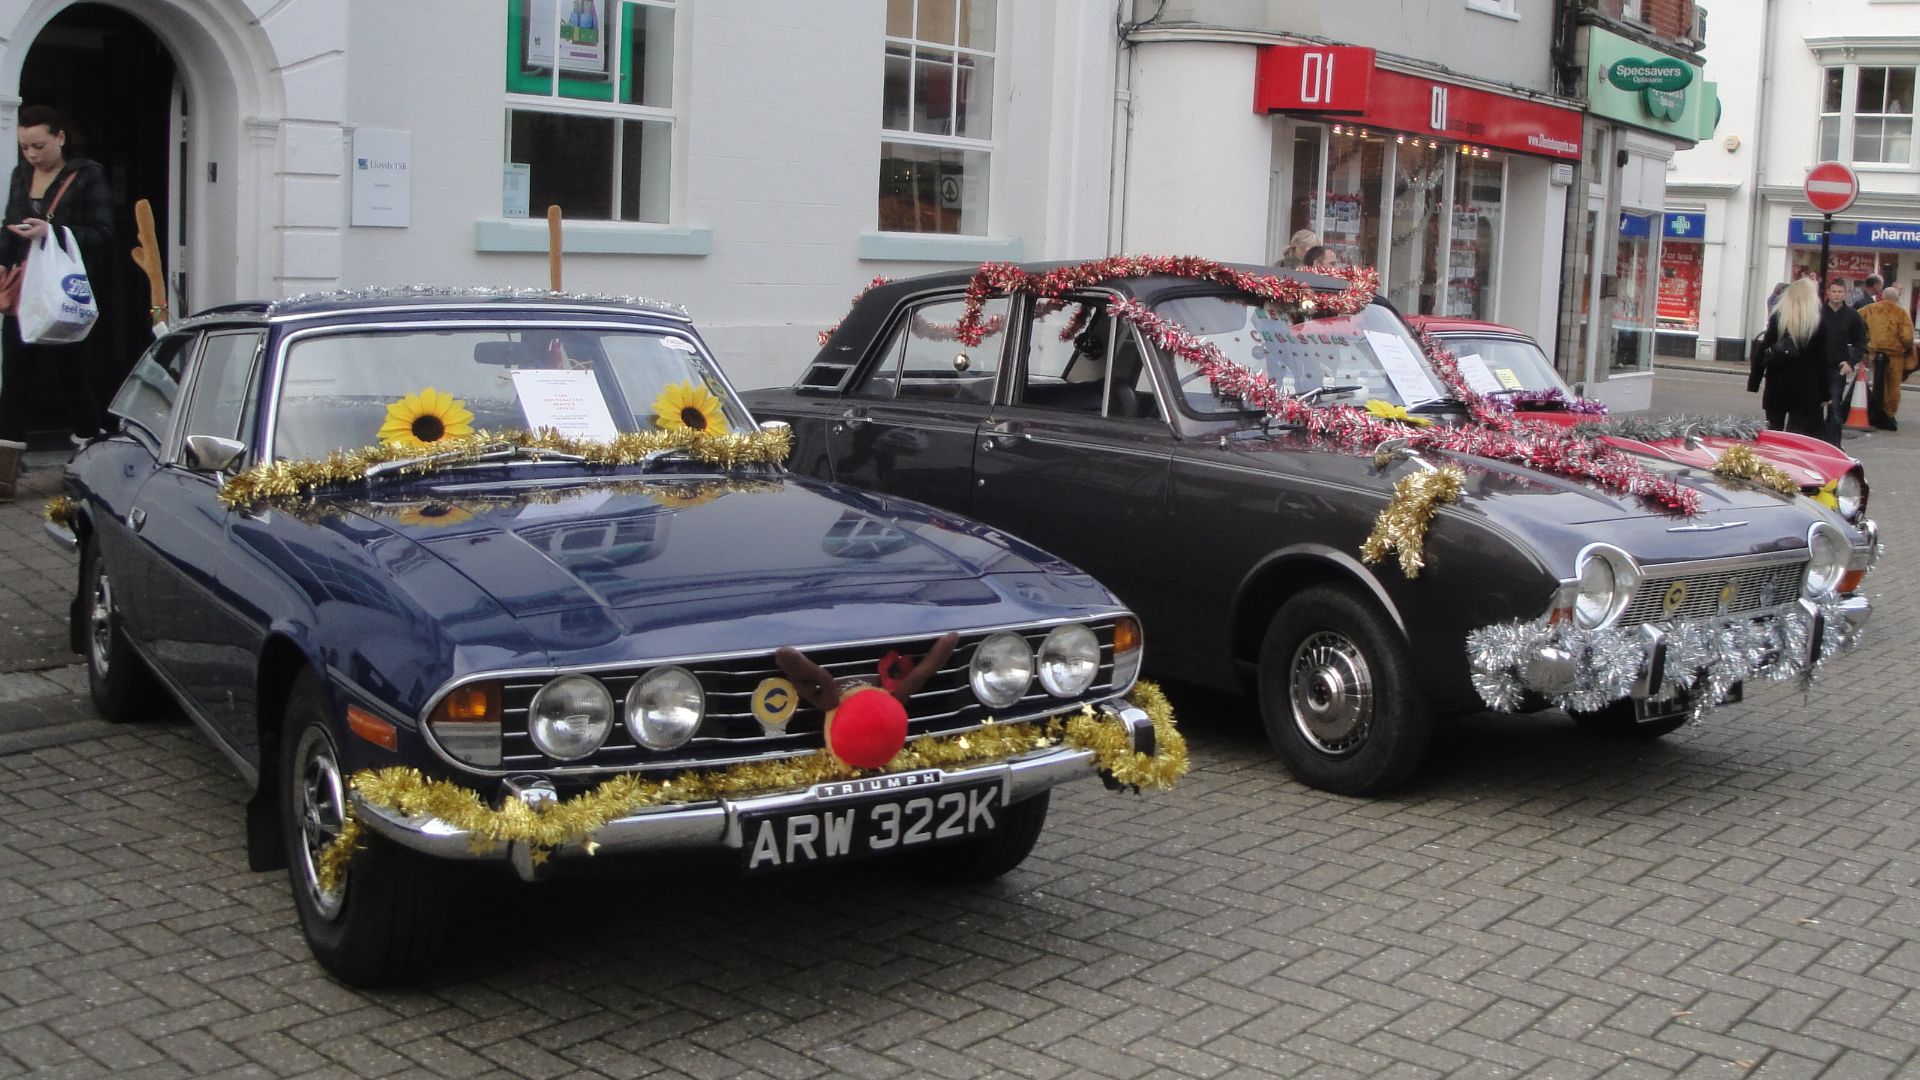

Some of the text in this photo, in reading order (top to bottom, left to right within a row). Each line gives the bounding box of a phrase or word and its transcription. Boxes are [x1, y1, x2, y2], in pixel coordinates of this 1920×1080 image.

[1300, 52, 1334, 104] 01
[1616, 64, 1681, 78] Specsavers
[1430, 85, 1448, 131] 01
[370, 160, 407, 171] Lloyds TSB
[1828, 254, 1838, 269] 3
[1850, 255, 1860, 270] 2
[62, 302, 78, 314] feel
[823, 772, 937, 797] TRIUMPH
[749, 785, 999, 869] ARW 322K
